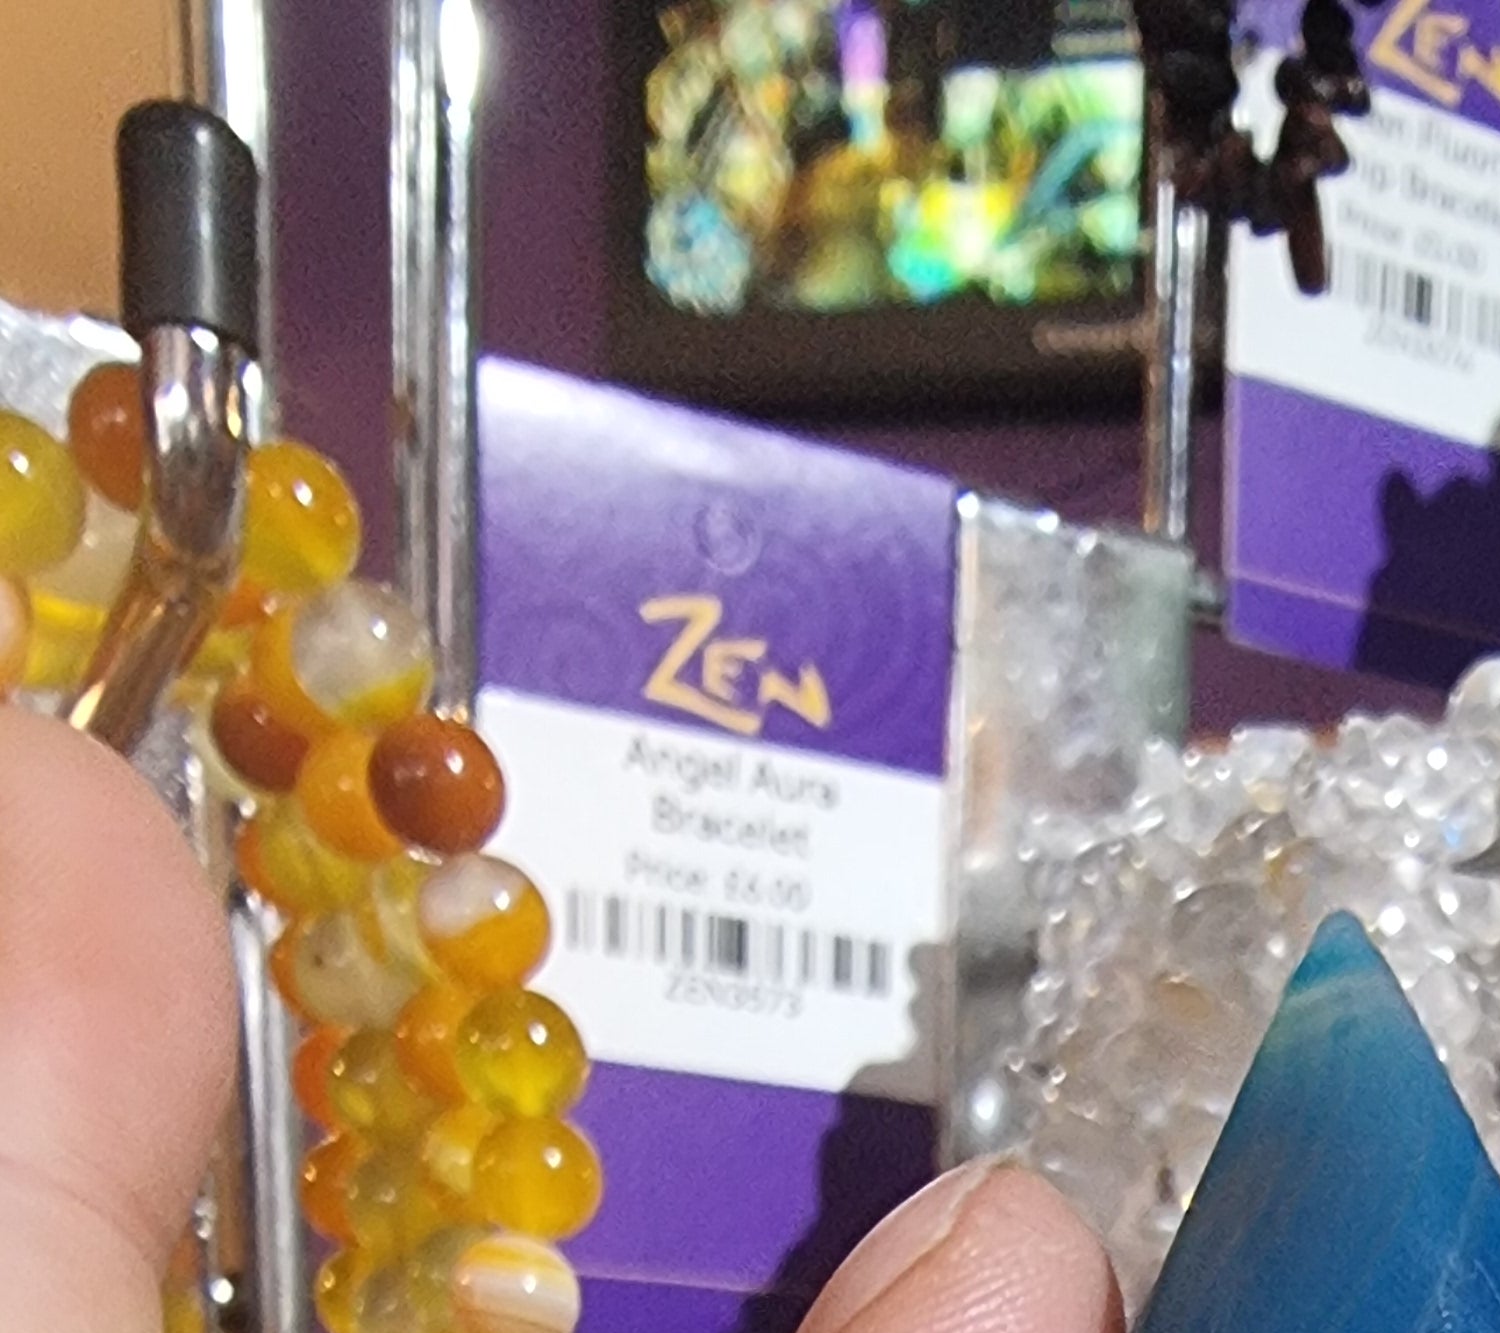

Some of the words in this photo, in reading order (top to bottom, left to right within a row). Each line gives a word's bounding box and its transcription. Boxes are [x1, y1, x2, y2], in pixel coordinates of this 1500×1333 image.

[639, 594, 831, 736] ZEN
[623, 734, 740, 794] Angel
[752, 758, 841, 812] Aura
[650, 793, 812, 858] Bracelet
[625, 847, 708, 893] Price
